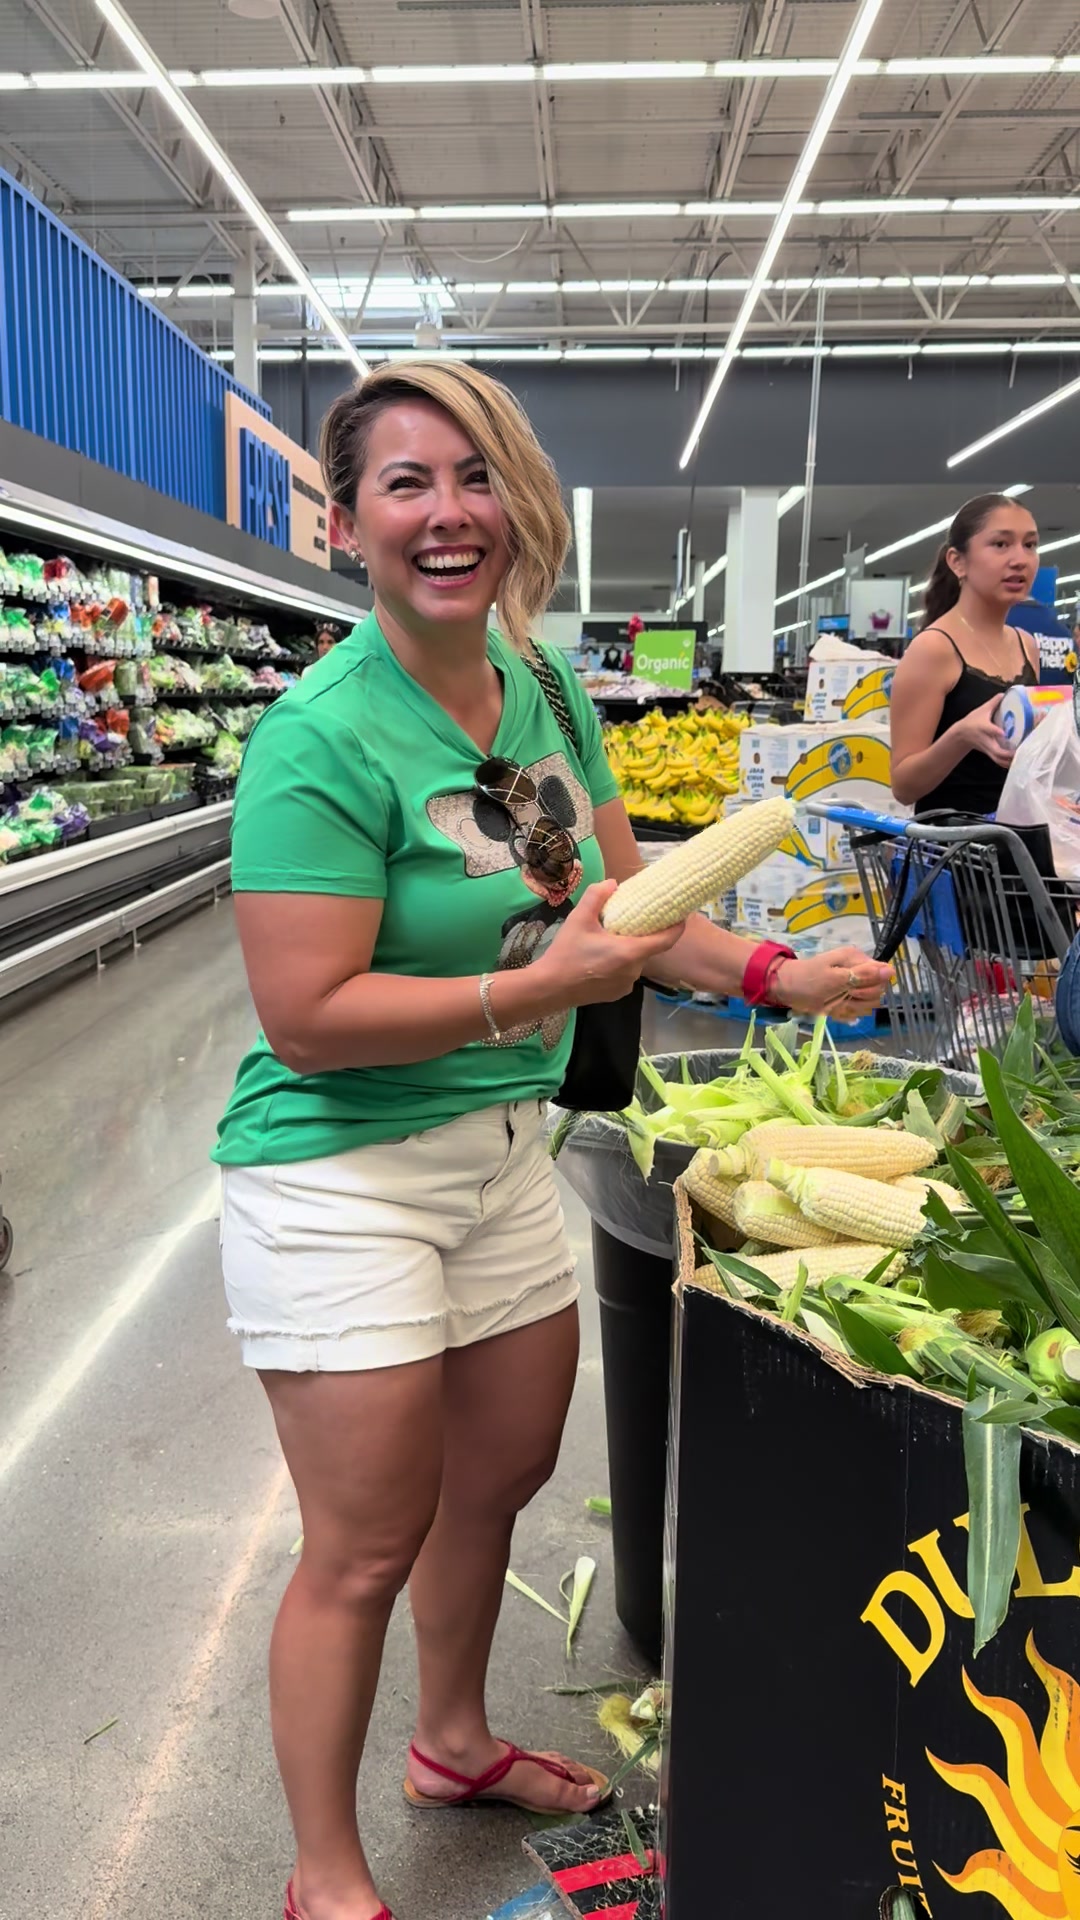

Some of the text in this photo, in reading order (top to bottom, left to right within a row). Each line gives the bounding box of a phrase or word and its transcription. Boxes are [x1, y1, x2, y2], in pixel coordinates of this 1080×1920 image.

[242, 428, 290, 551] FRESH
[636, 653, 690, 675] Organic
[860, 1502, 1080, 1688] DUL
